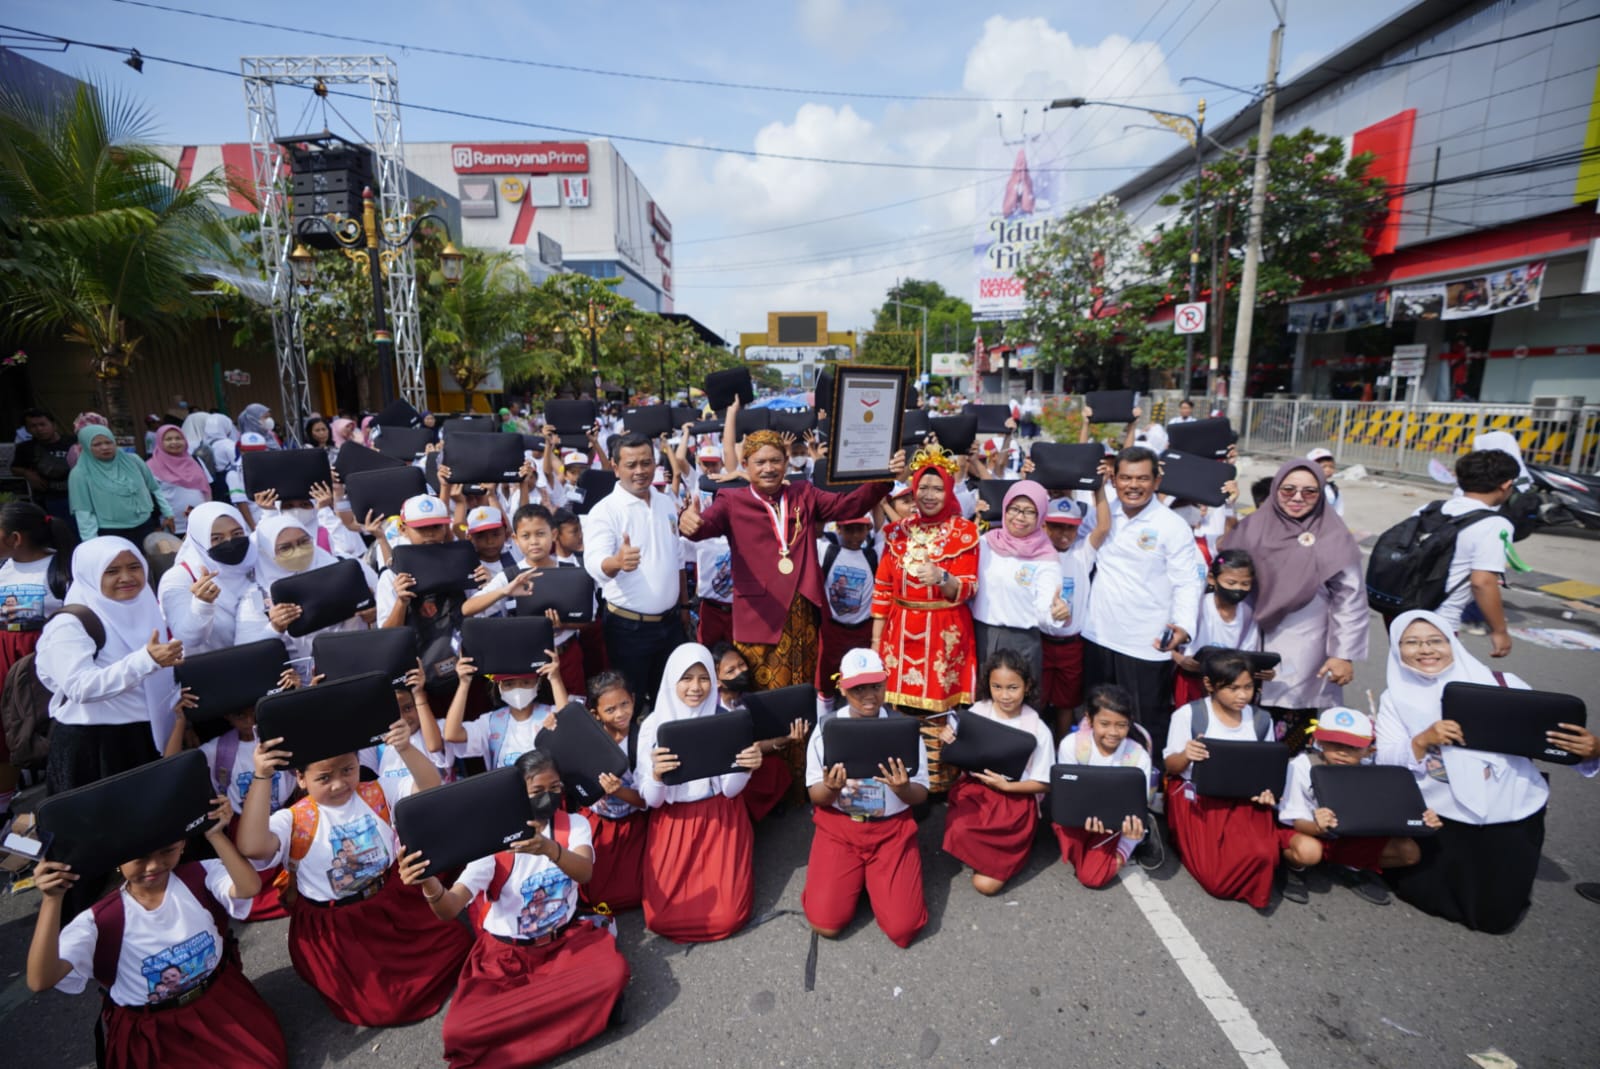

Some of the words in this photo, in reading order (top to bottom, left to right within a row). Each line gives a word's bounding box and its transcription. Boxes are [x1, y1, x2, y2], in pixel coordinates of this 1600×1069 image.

[1544, 748, 1567, 756] acer
[186, 814, 206, 832] acer
[503, 831, 524, 843] acer
